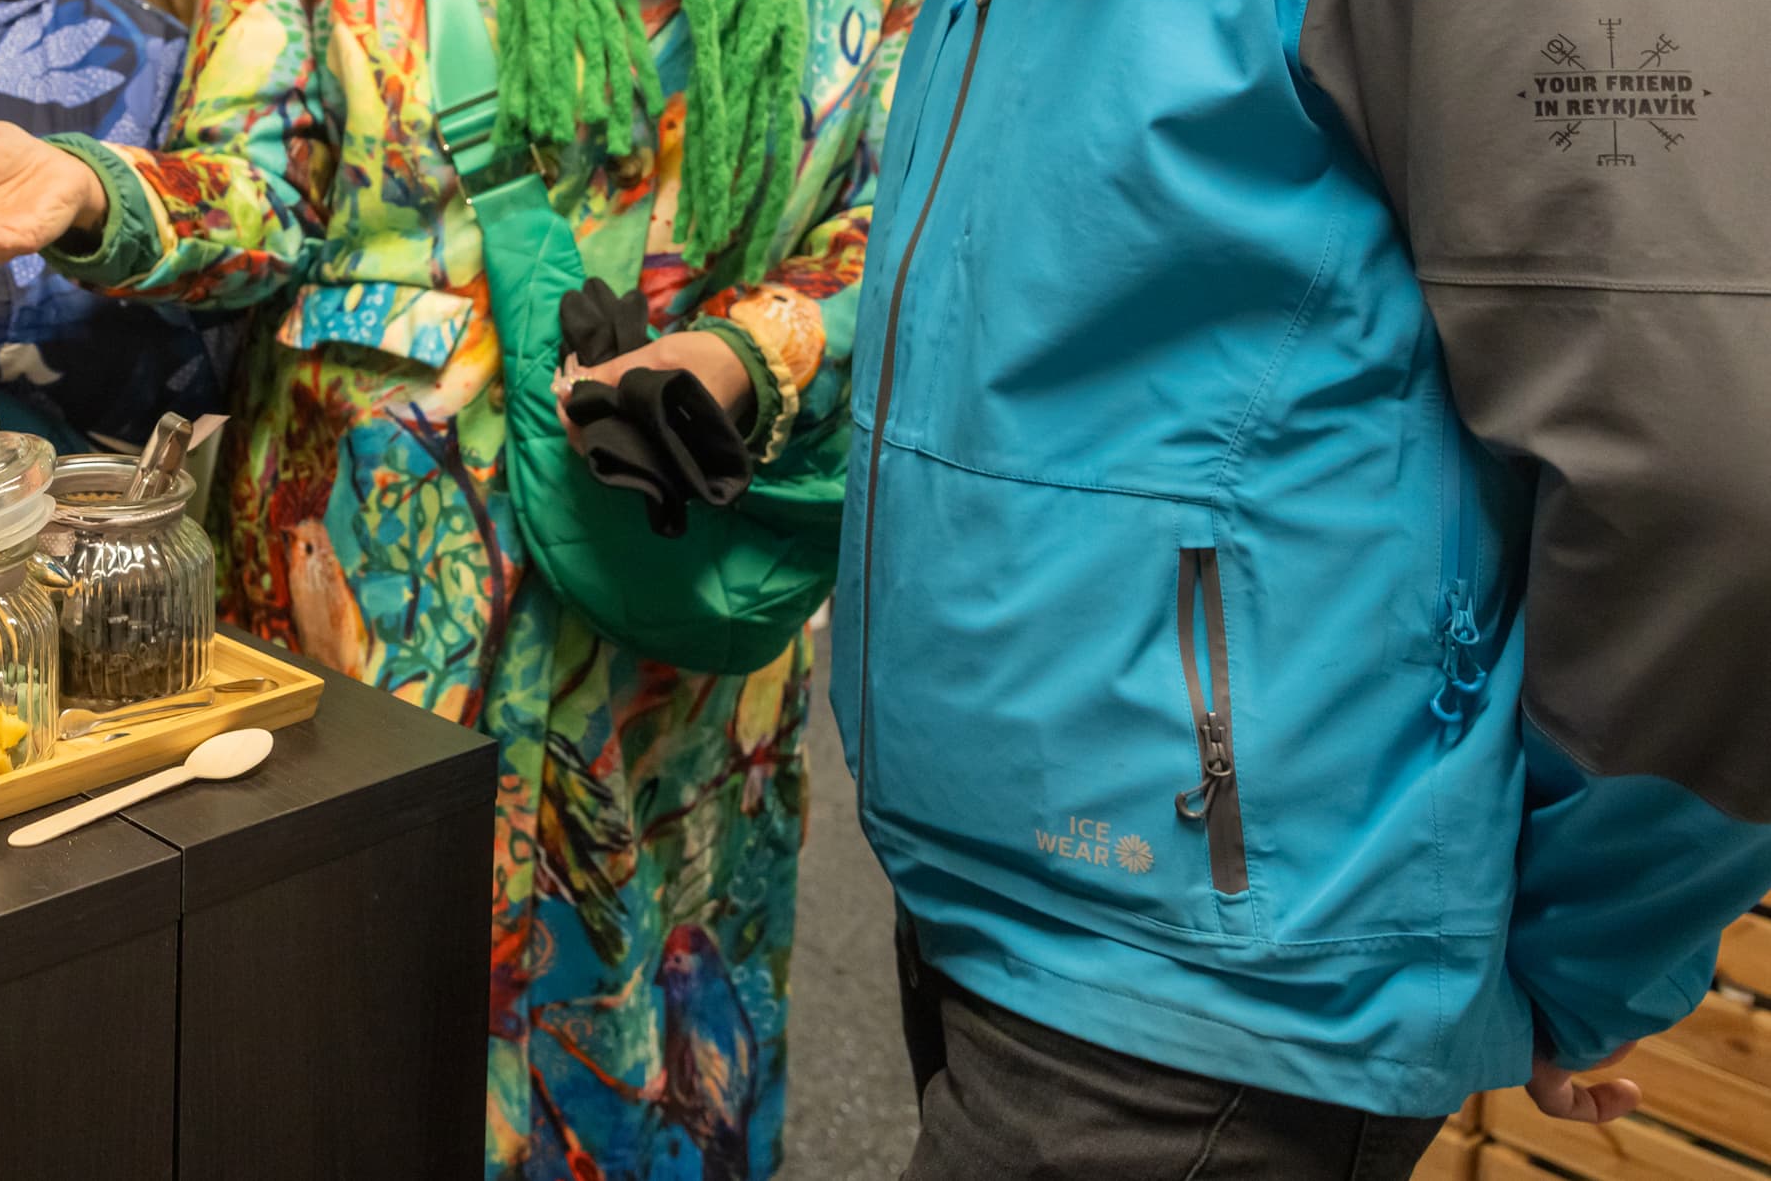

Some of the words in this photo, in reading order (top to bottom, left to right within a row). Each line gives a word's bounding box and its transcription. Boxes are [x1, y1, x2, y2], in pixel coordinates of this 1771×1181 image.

[1534, 76, 1598, 94] YOUR
[1606, 75, 1693, 92] FRIEND
[1534, 99, 1558, 117] IN
[1566, 94, 1696, 118] REYKJAVÍK
[1069, 816, 1111, 843] ICE
[1035, 828, 1110, 867] WEAR
